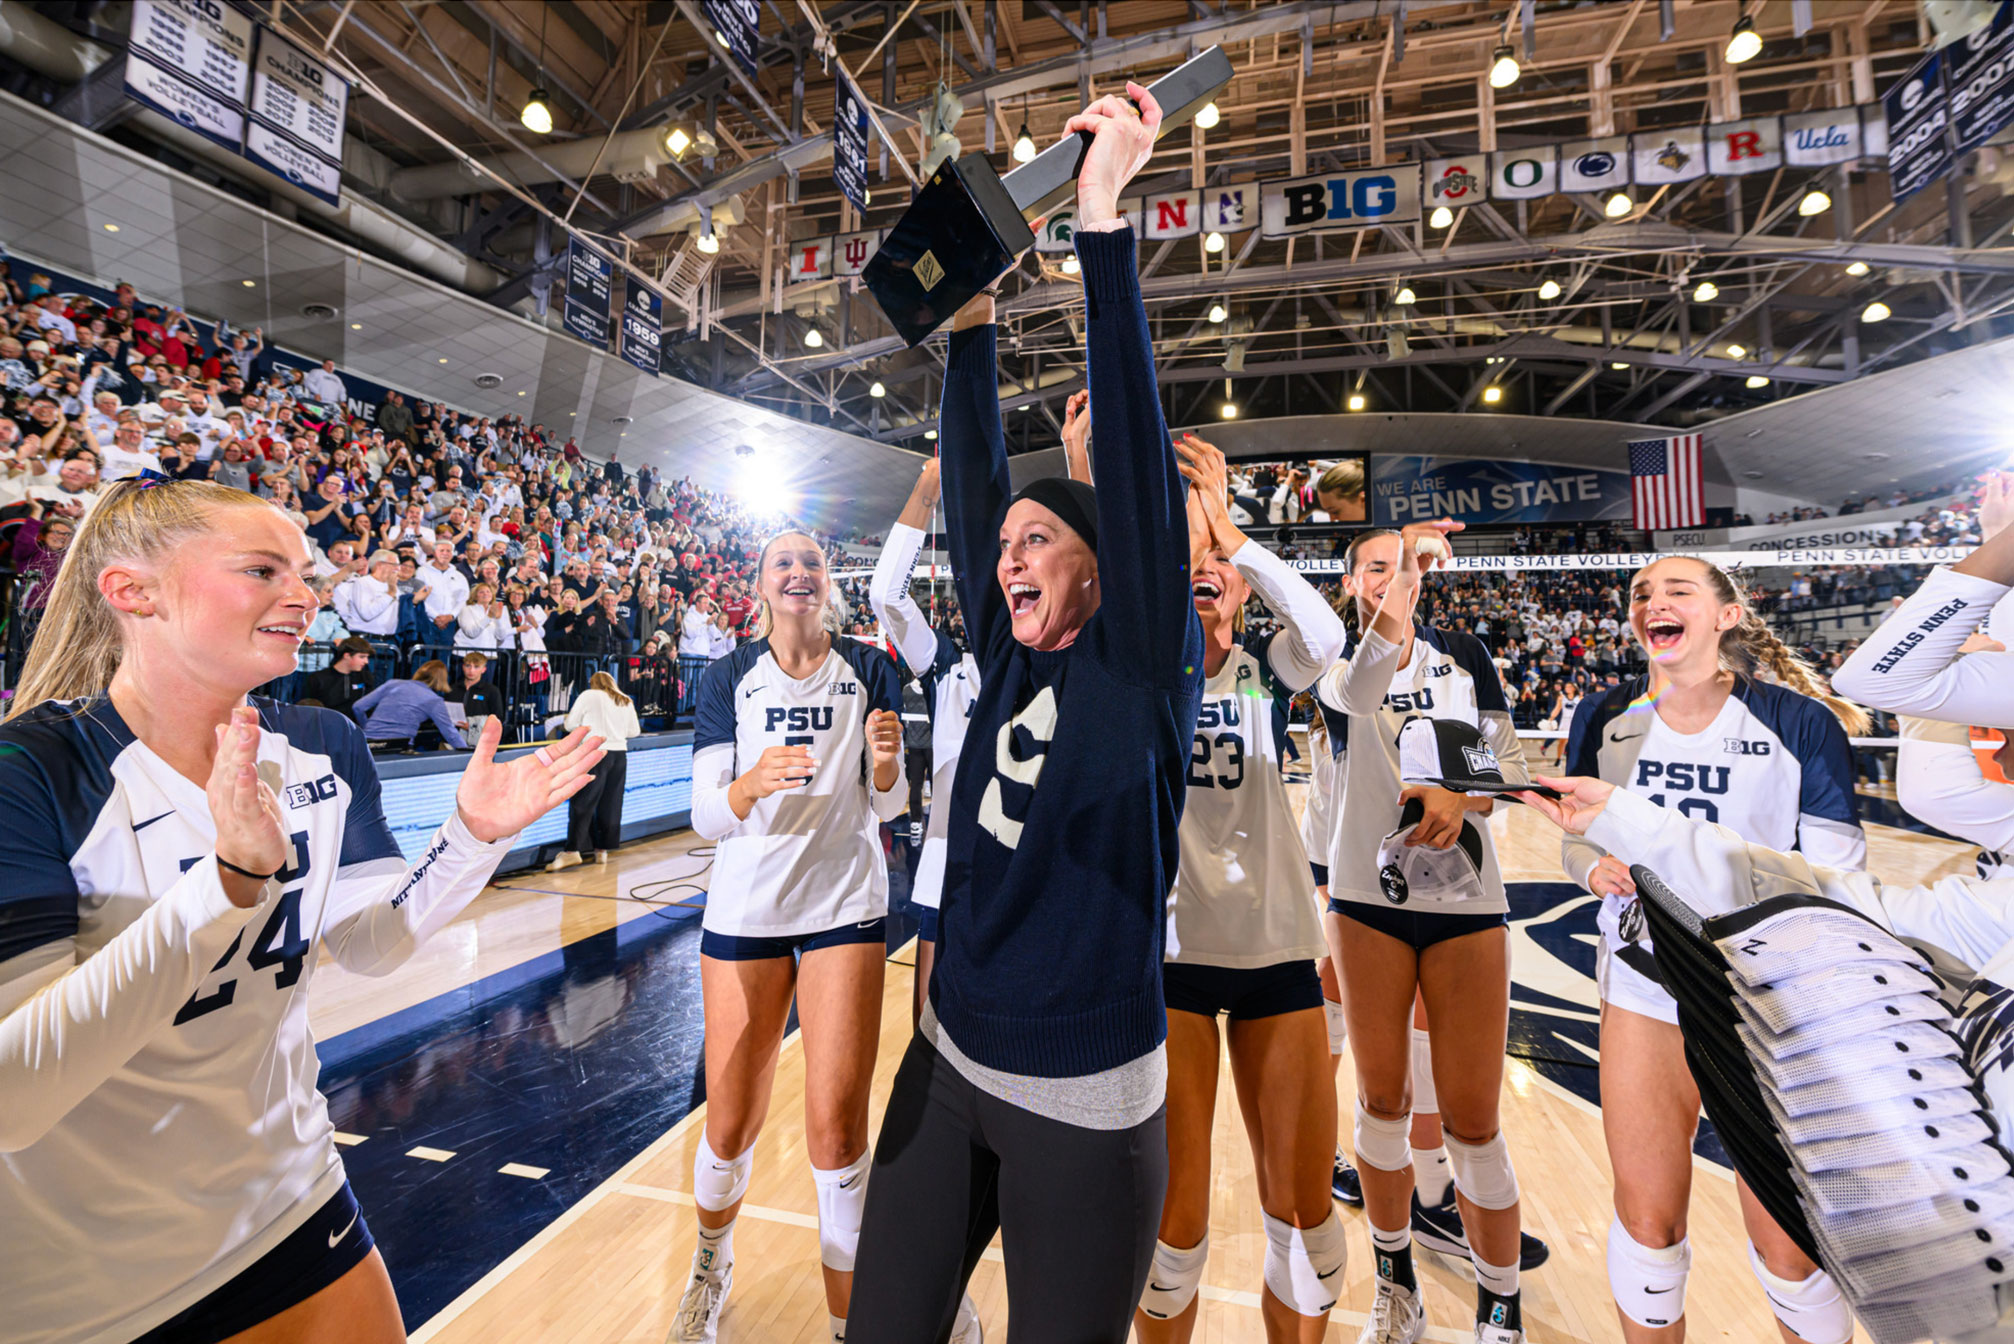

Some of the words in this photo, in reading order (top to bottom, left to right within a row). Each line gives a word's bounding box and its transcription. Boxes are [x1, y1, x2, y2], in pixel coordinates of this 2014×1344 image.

[266, 55, 341, 109] CHAMPIONS
[1726, 131, 1763, 161] R
[1889, 109, 1946, 167] 2004
[1157, 198, 1188, 231] N
[626, 318, 660, 346] 1959
[1376, 480, 1404, 497] WE
[1410, 475, 1448, 493] ARE
[1389, 486, 1482, 522] PENN
[1490, 473, 1602, 511] STATE
[1457, 557, 1506, 568] PENN
[1513, 555, 1570, 568] STATE
[1778, 551, 1834, 562] PENN
[1844, 547, 1911, 561] STATE
[1918, 598, 1969, 633] PENN
[1871, 632, 1925, 674] STATE
[765, 706, 833, 732] PSU
[1196, 699, 1240, 729] SU
[1186, 732, 1245, 790] 23
[1636, 759, 1731, 795] PSU
